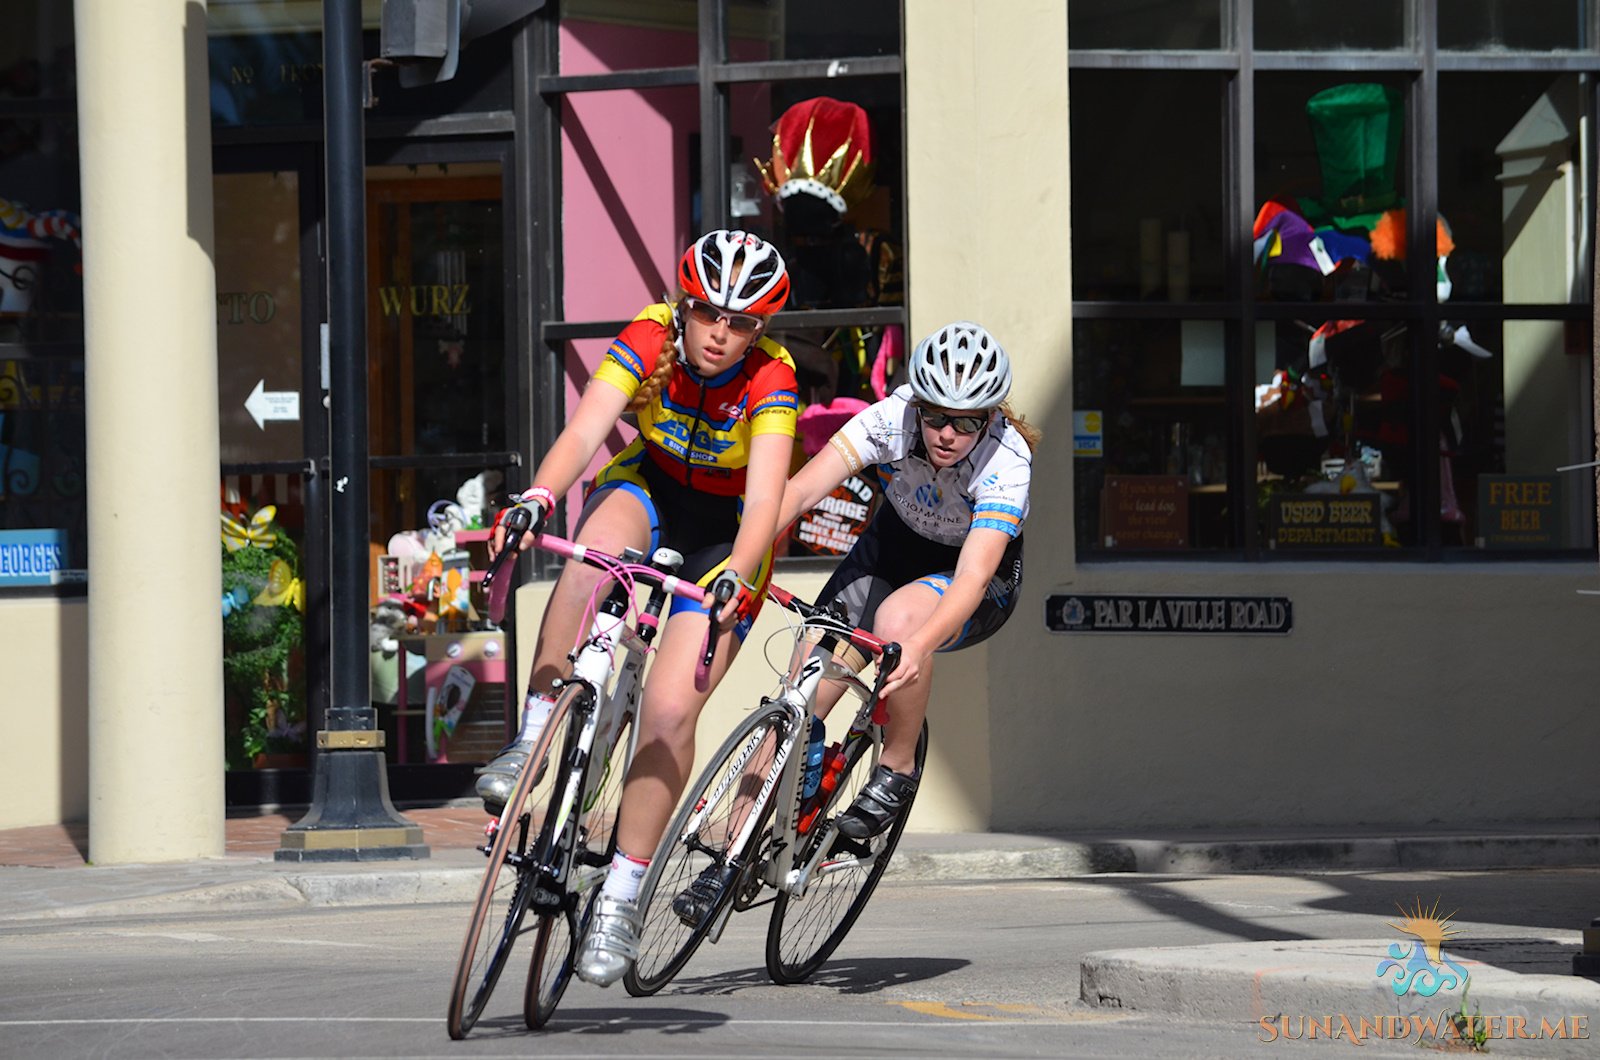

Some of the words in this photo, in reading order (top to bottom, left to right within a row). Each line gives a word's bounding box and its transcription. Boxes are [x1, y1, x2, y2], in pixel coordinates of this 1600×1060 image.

[216, 290, 276, 325] TO
[378, 284, 471, 316] WURZ
[668, 440, 685, 454] BIKE
[690, 451, 714, 462] SHOP
[1136, 498, 1156, 512] lead
[1488, 481, 1552, 506] FREE
[812, 496, 869, 522] ARAGE
[1280, 500, 1325, 524] USED
[1328, 500, 1373, 524] BEER
[1500, 509, 1541, 531] BEER
[1278, 527, 1376, 544] DEPARTMENT
[0, 543, 62, 577] EORGES
[1094, 600, 1133, 628] PAR
[1231, 601, 1286, 630] ROAD
